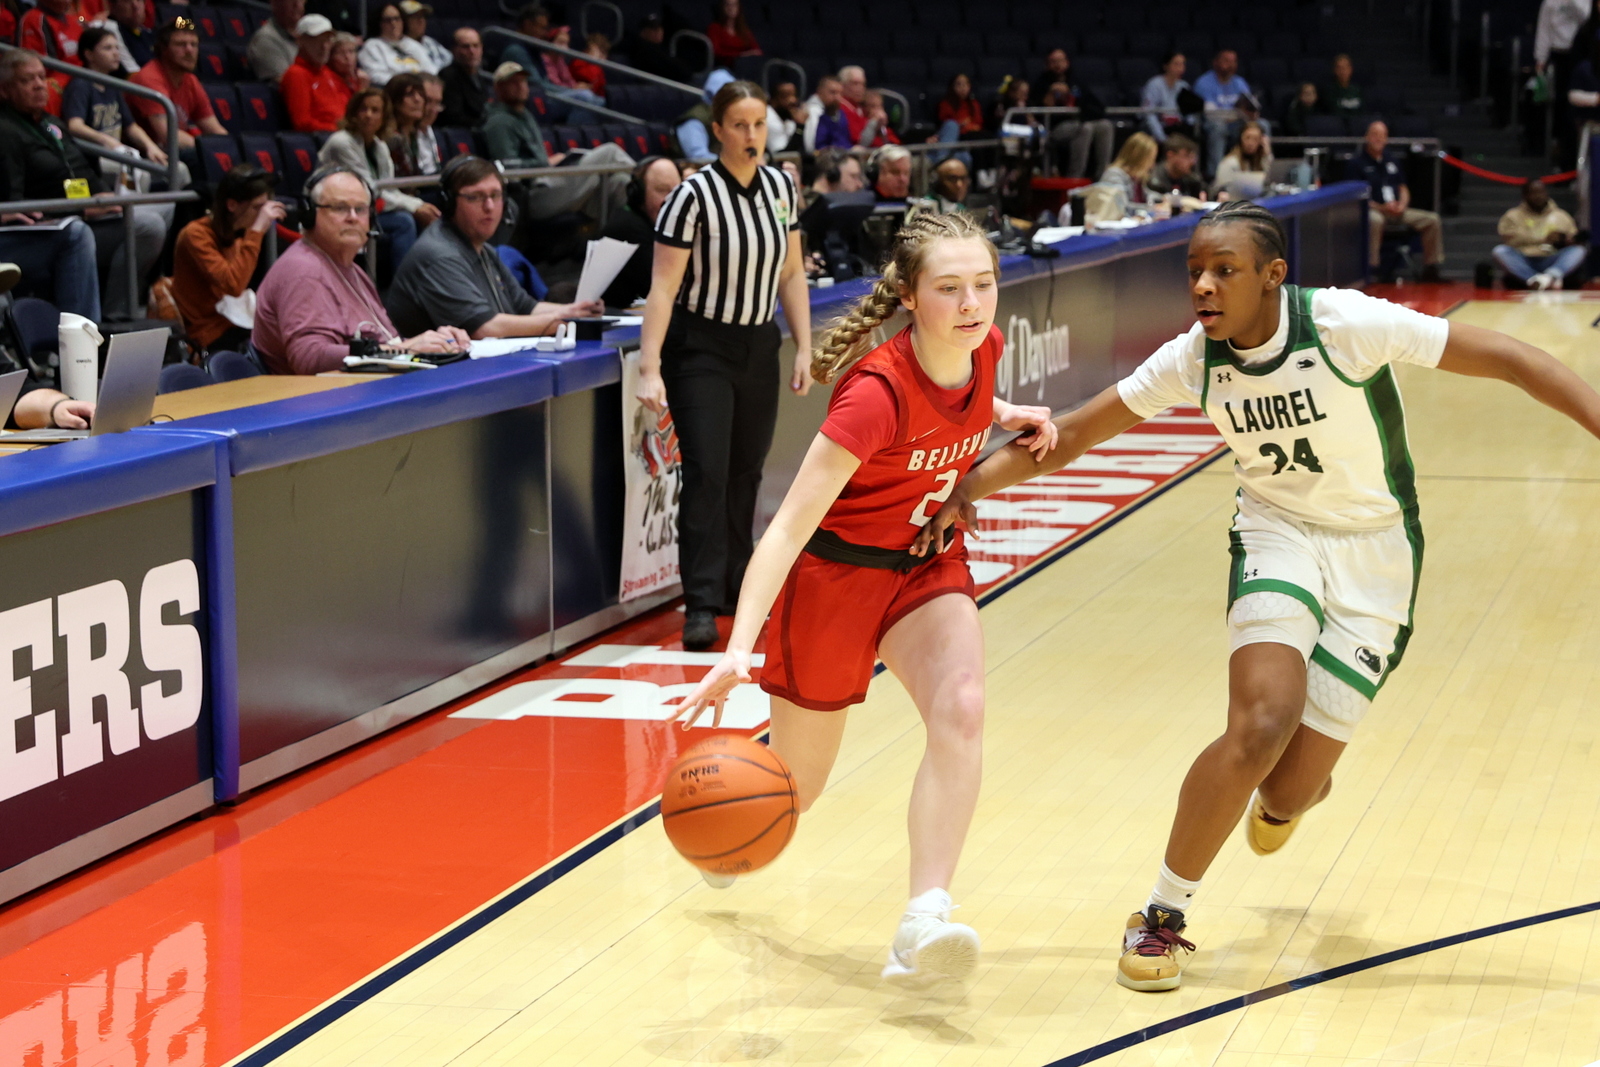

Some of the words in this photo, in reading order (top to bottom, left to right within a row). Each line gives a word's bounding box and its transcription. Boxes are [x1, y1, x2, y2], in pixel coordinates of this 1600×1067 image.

[1019, 317, 1070, 401] Dayton
[1225, 388, 1327, 433] LAUREL
[907, 421, 993, 471] BELLEVU
[1259, 437, 1324, 476] 24
[908, 469, 959, 528] 2
